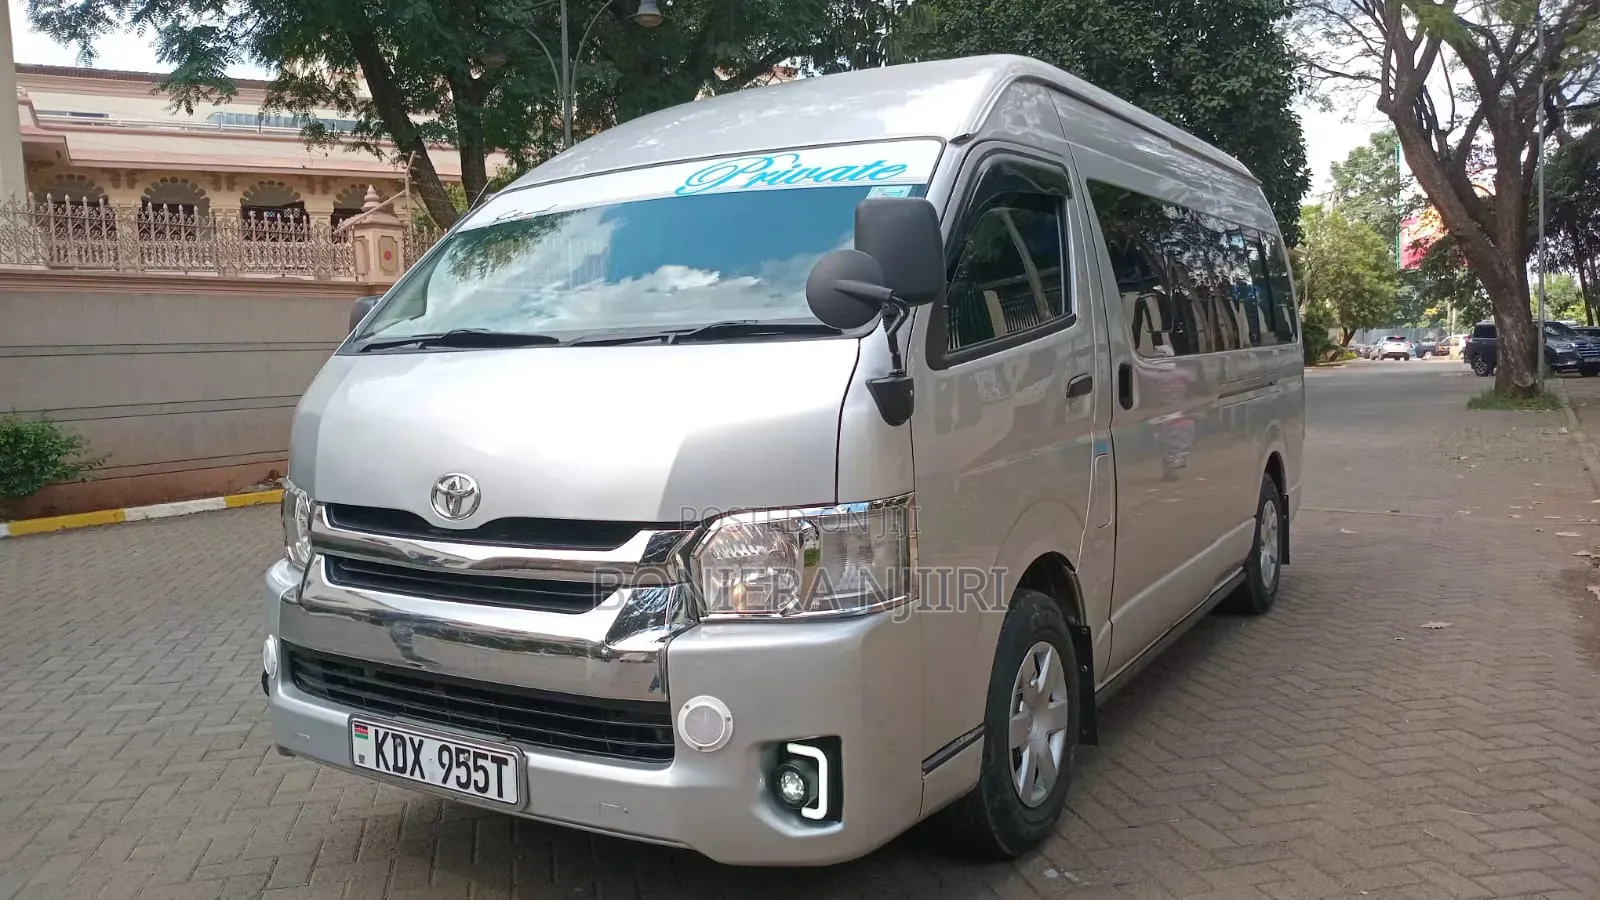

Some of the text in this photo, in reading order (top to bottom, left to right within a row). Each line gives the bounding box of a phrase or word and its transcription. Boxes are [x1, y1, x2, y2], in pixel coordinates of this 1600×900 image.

[675, 153, 908, 196] Private
[374, 728, 508, 798] KDX 955T
